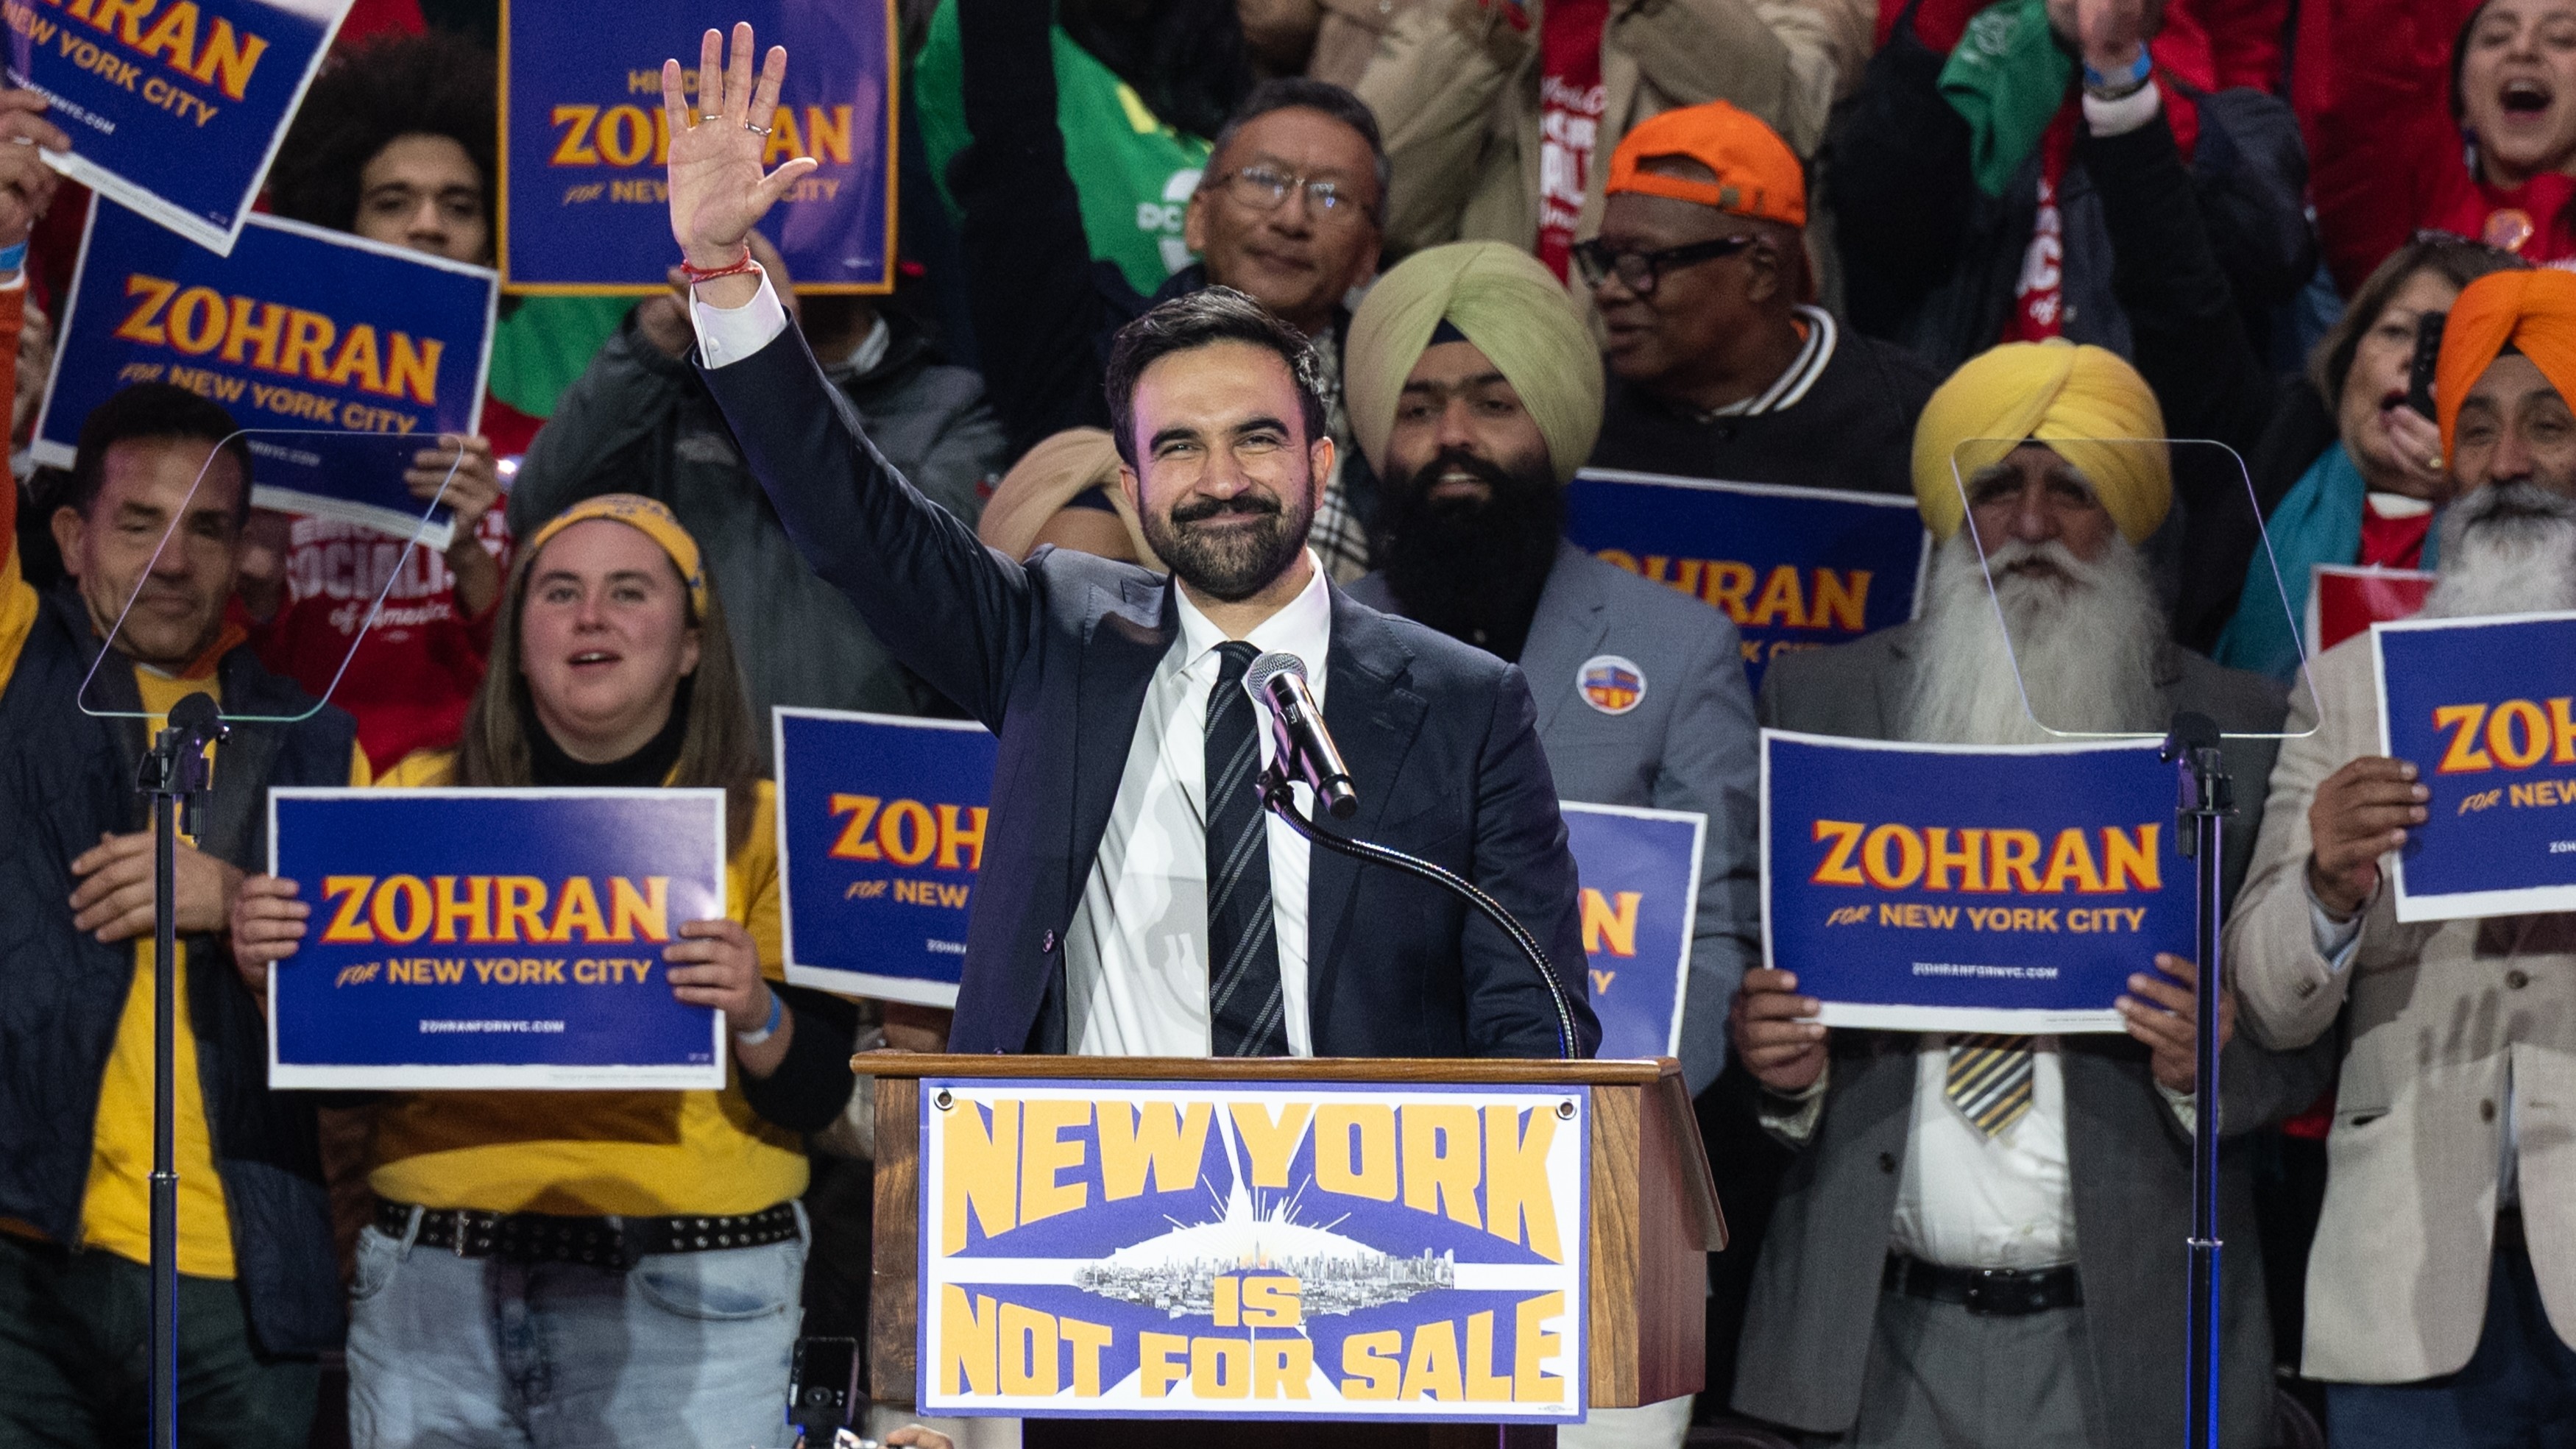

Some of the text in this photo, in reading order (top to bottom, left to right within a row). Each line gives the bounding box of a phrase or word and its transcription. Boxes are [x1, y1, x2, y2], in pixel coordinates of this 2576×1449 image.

[60, 30, 142, 92] YORK
[142, 77, 219, 127] CITY
[549, 104, 853, 167] ZOAN
[113, 272, 445, 407] ZOHRAN
[169, 364, 247, 403] NEW
[252, 382, 338, 424] YORK
[341, 403, 419, 436] CITY
[827, 793, 990, 871] ZOH
[2458, 787, 2502, 817] FOR
[1810, 818, 2162, 894] ZOHRAN
[319, 874, 671, 946] ZOHRAN
[845, 878, 969, 910] FOR NEW
[1826, 902, 2147, 934] FOR NEW YORK CITY
[336, 958, 654, 989] FOR NEW YORK CITY
[942, 1098, 1565, 1265] NEW YORK
[1213, 1275, 1302, 1328] IS
[939, 1281, 1566, 1403] NOT FOR SALE
